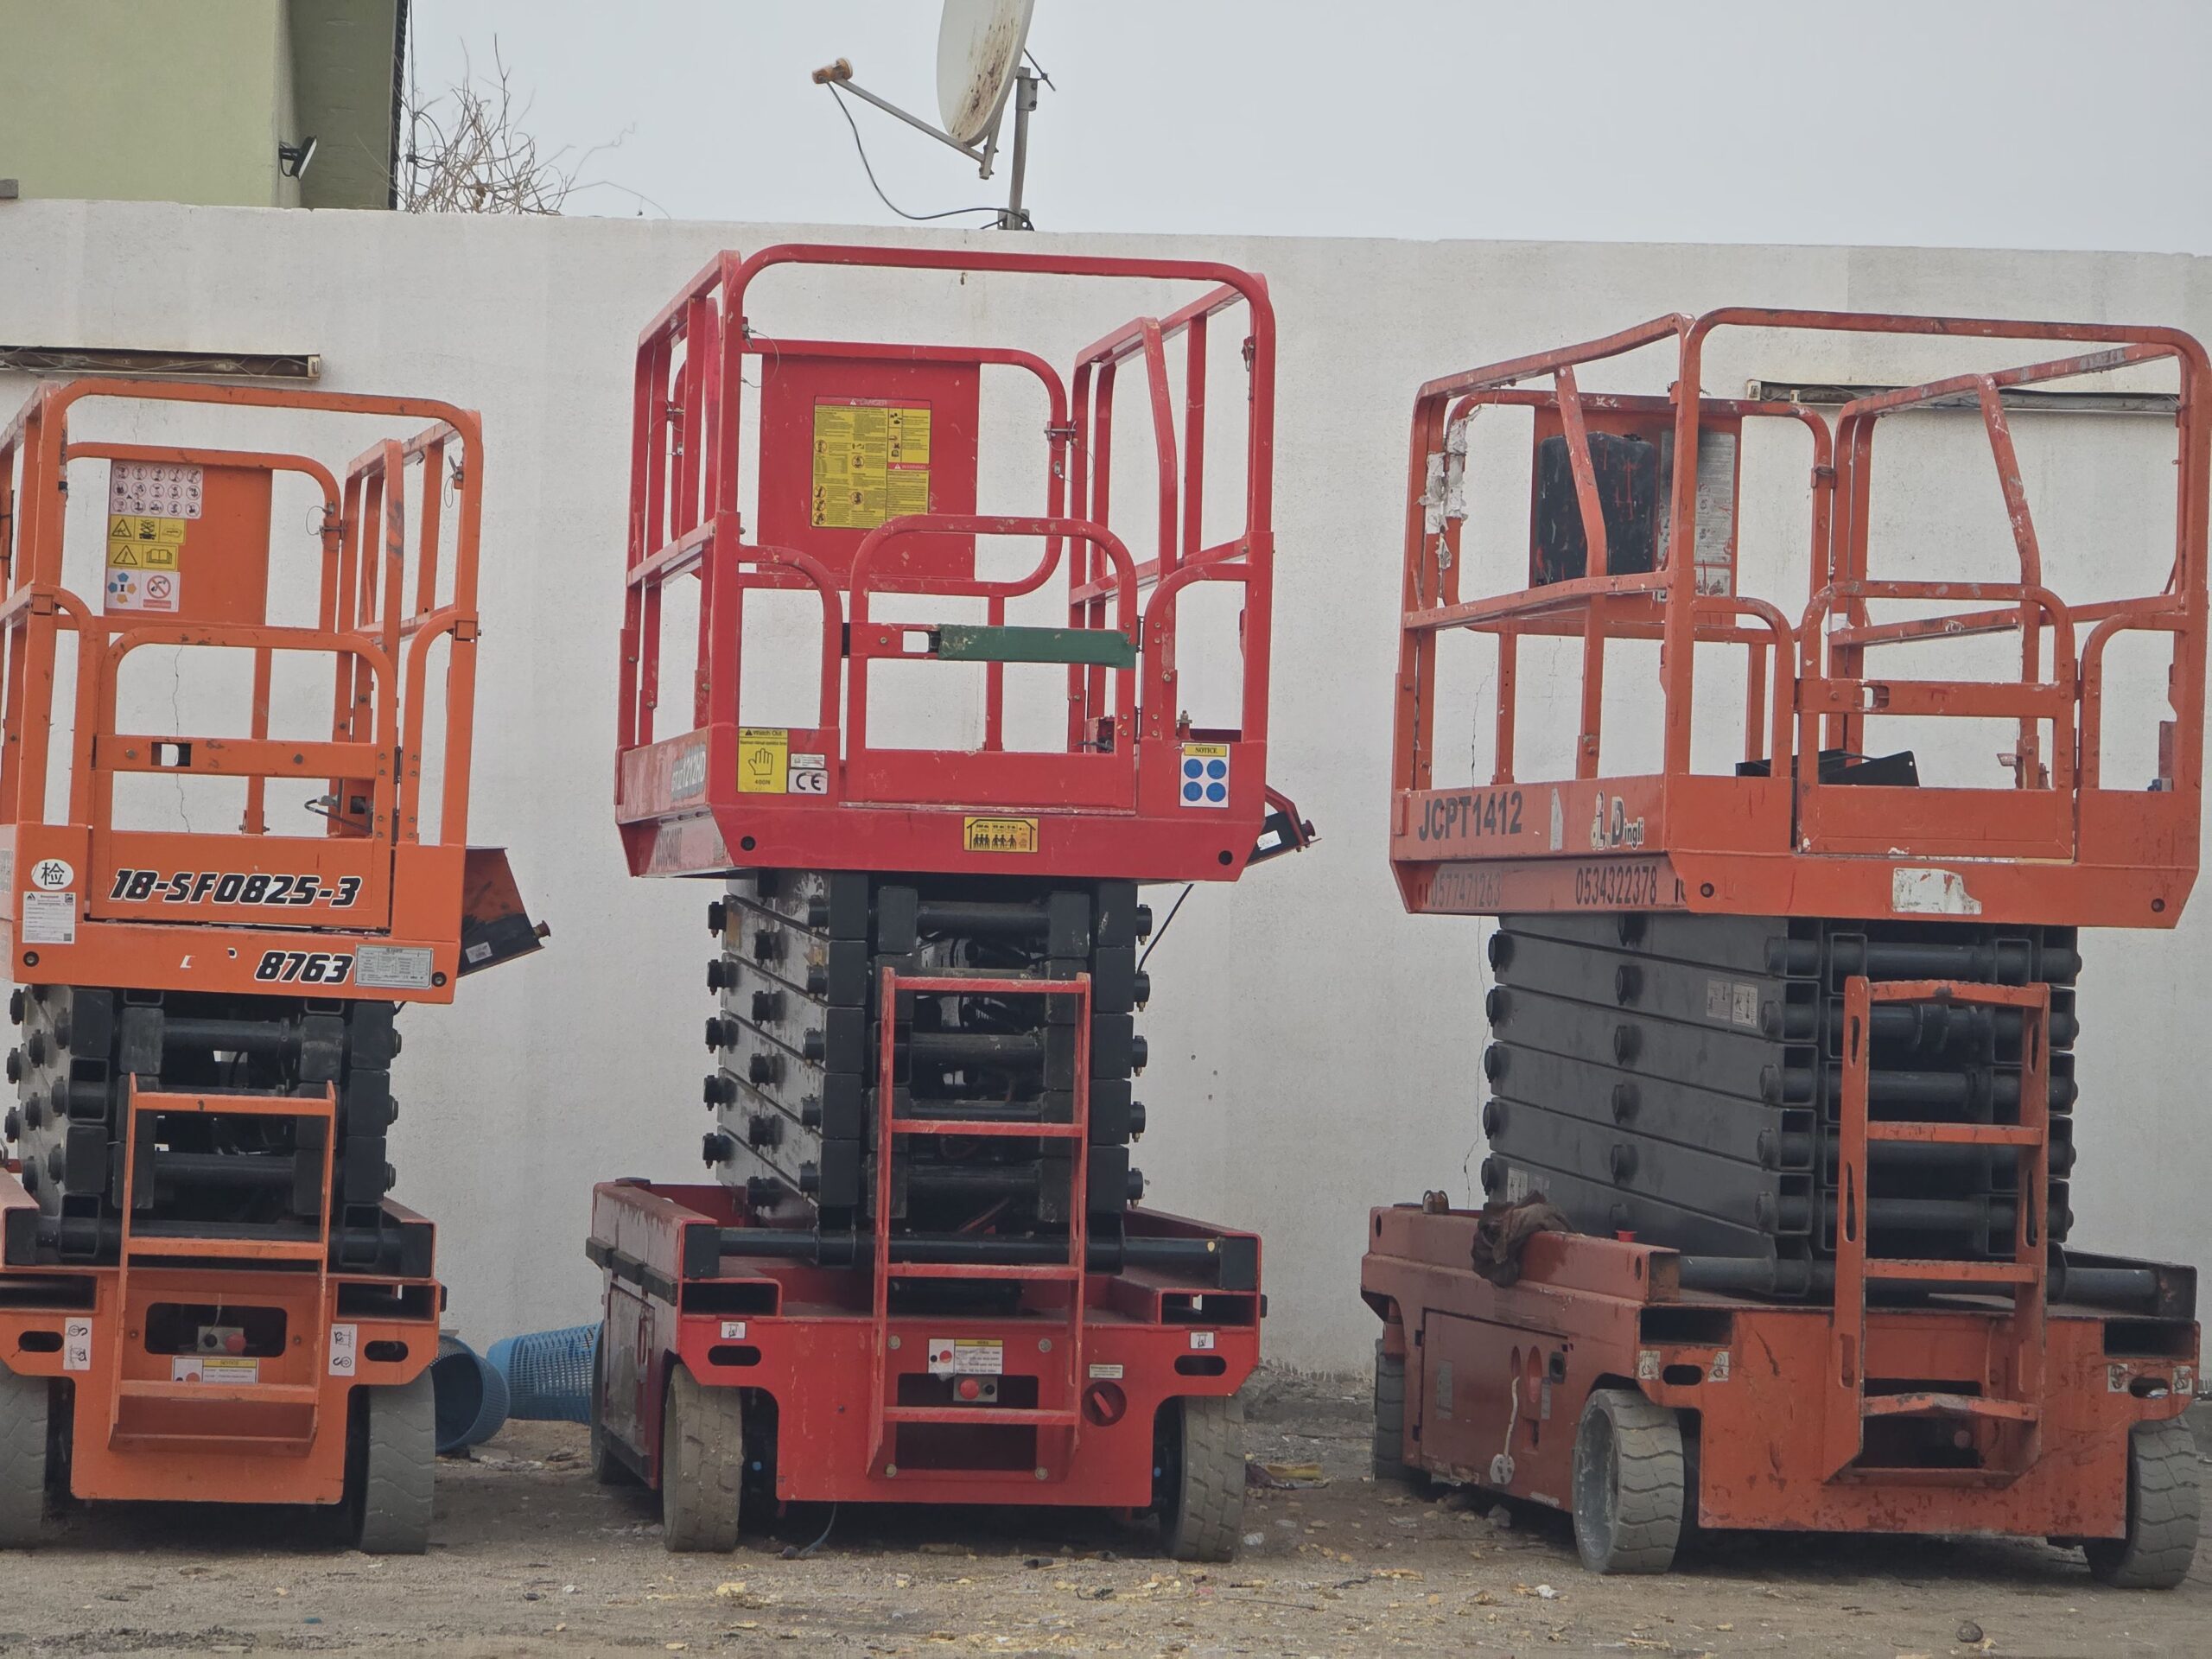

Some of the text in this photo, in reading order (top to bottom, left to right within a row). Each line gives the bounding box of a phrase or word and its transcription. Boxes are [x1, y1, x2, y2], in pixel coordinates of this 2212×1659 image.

[796, 772, 822, 791] CE
[1418, 790, 1523, 842] JCPT1412
[1611, 798, 1644, 849] Dingli
[41, 861, 65, 886] 检
[110, 868, 362, 907] 18-SF0825-3
[1575, 865, 1657, 906] 0534322378
[255, 950, 354, 984] 8763
